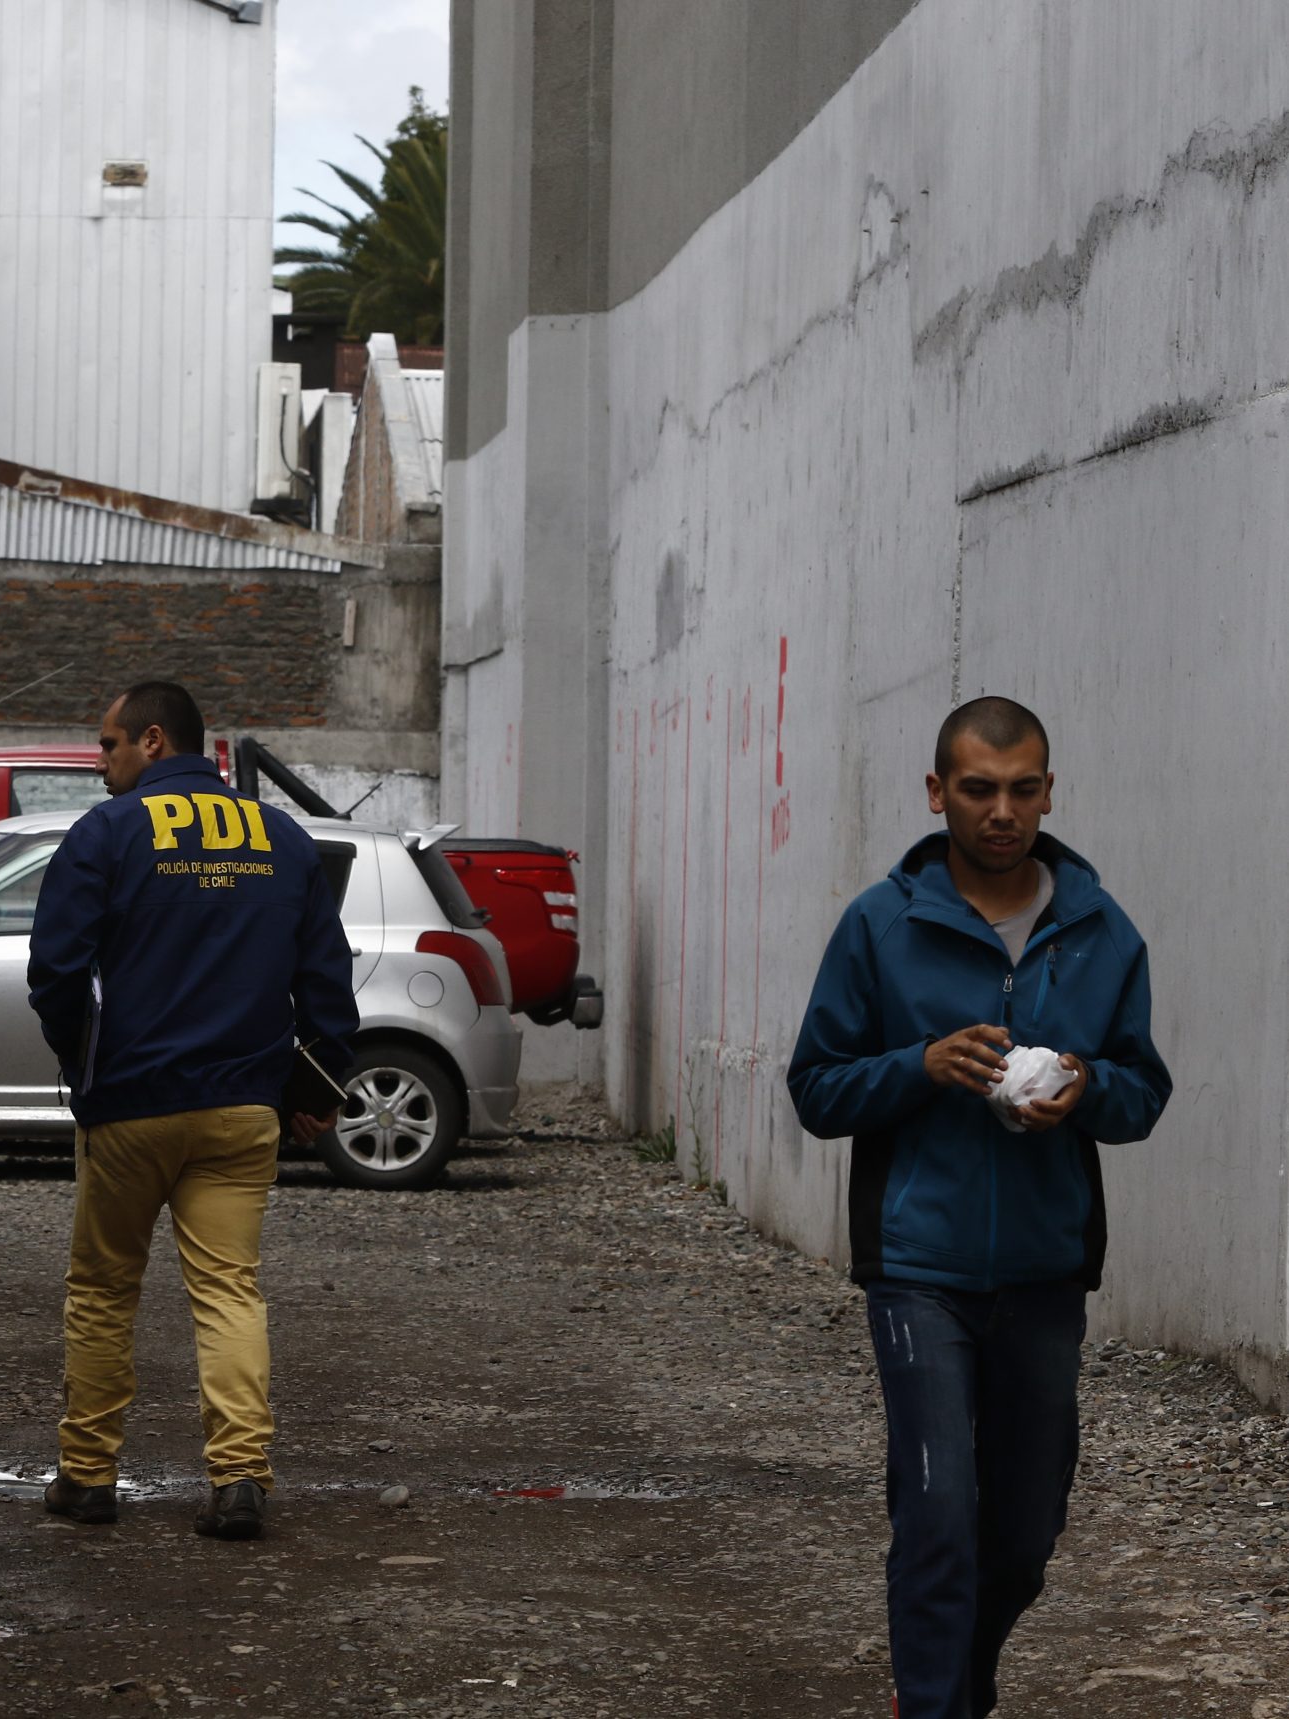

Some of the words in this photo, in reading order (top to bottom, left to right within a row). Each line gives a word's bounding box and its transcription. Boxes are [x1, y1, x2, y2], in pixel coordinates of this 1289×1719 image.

[141, 793, 272, 852] PDI
[157, 860, 189, 874] POLICÍA
[191, 862, 202, 873] DE
[203, 862, 274, 876] INVESTIGACIONES
[199, 876, 210, 888] DE
[211, 876, 235, 888] CHILE
